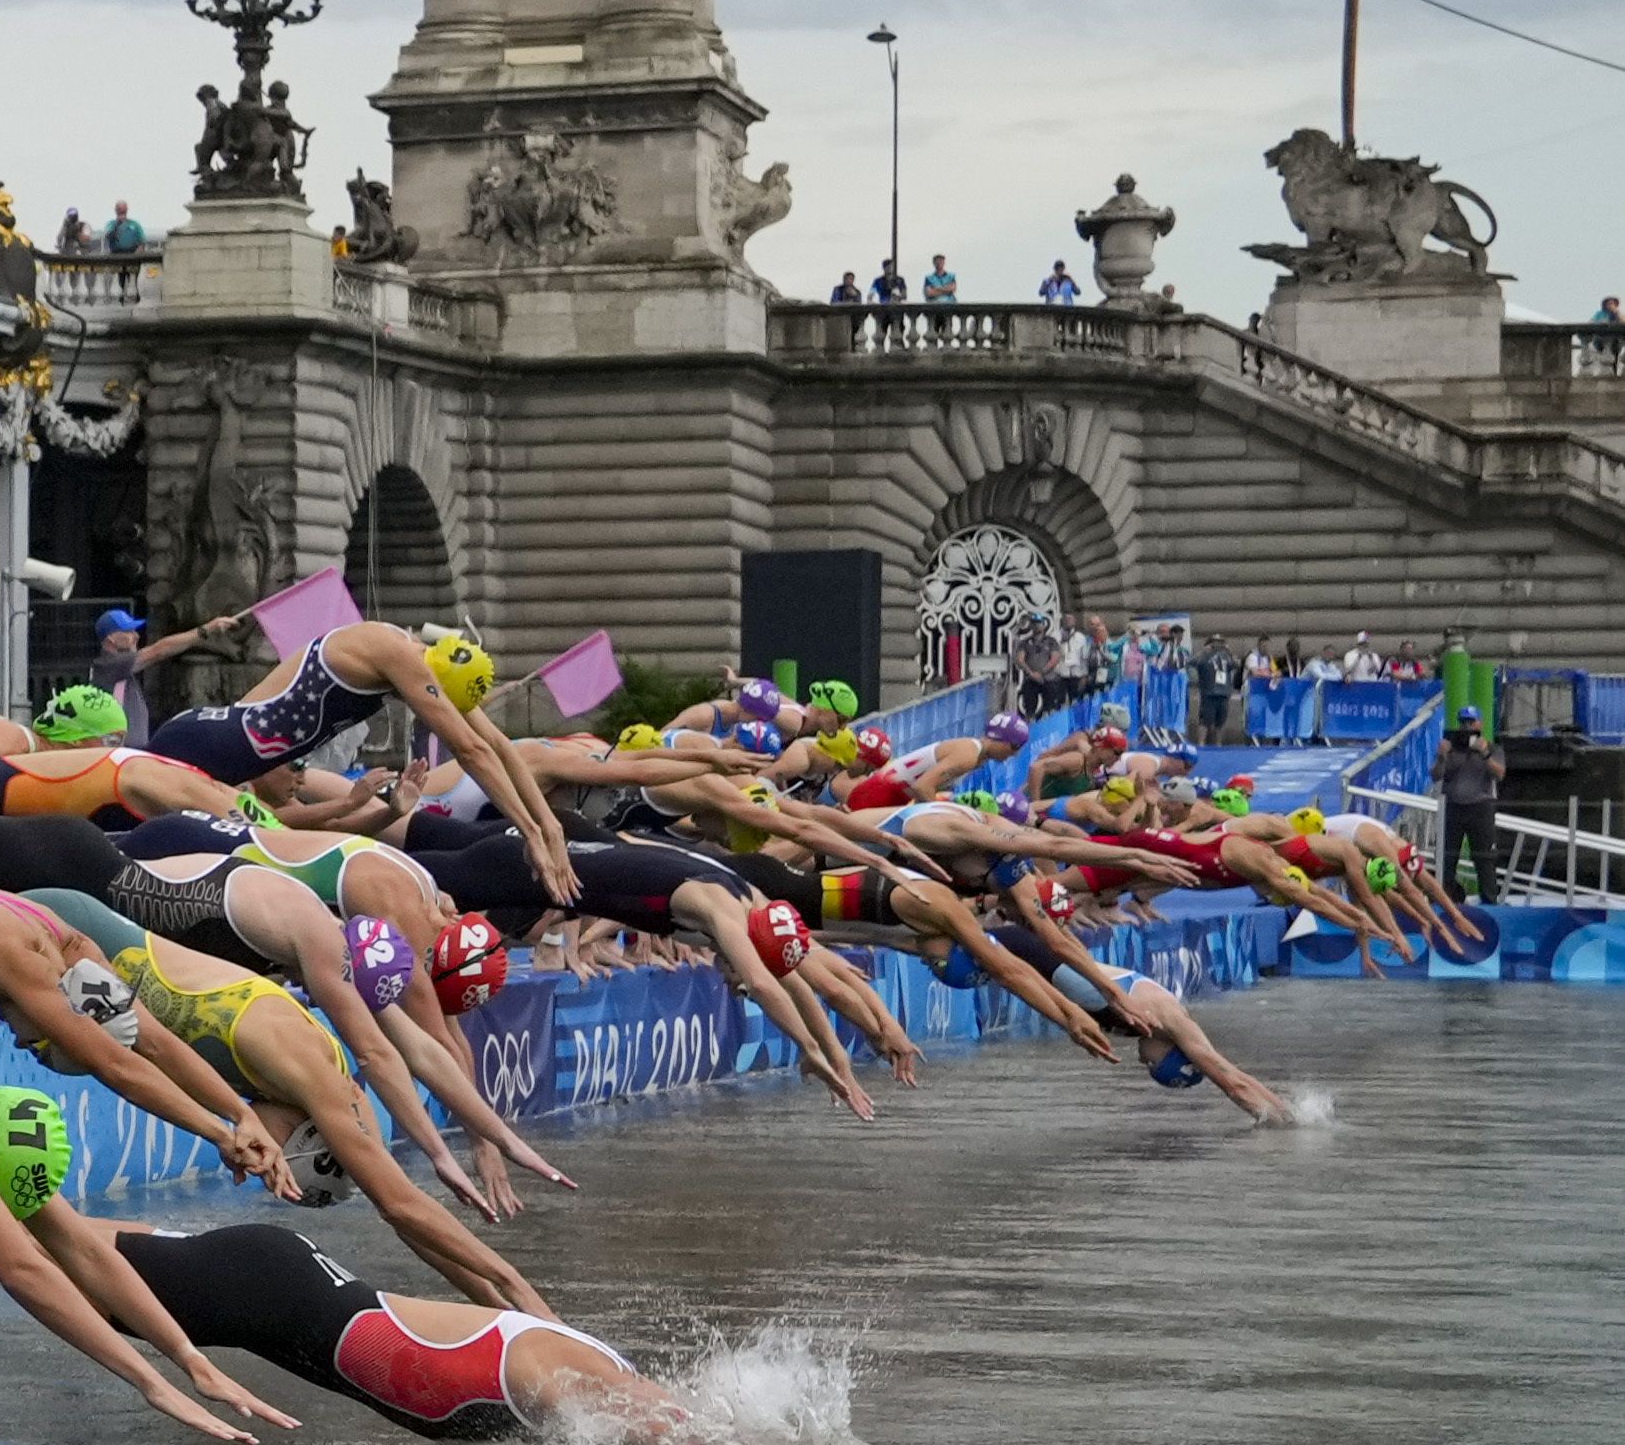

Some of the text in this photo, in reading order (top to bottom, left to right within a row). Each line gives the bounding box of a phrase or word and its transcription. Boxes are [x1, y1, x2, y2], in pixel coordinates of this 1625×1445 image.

[357, 919, 395, 969] 52
[768, 904, 797, 936] 27
[644, 1013, 720, 1096] 2024
[8, 1098, 49, 1151] 47
